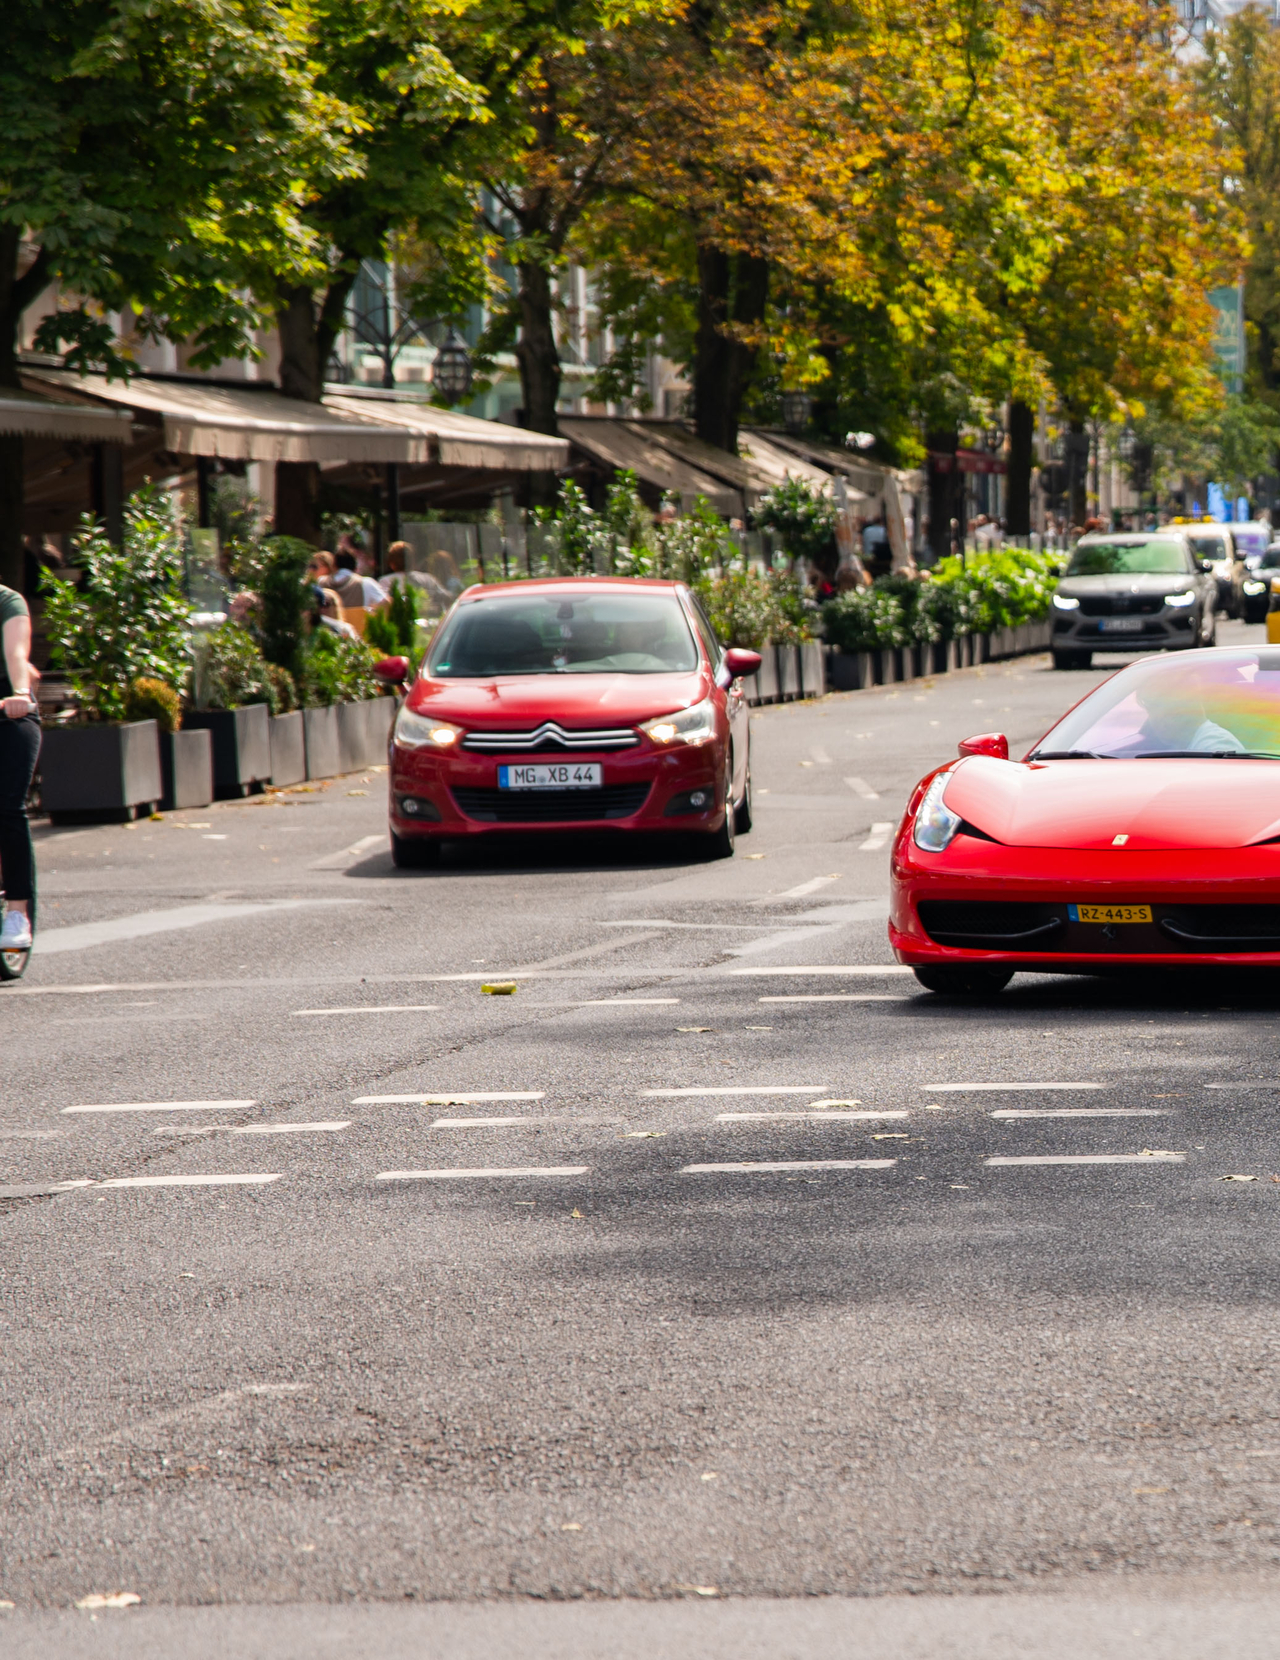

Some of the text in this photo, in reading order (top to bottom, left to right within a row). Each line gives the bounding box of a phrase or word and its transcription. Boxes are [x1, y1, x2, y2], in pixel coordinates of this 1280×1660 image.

[514, 766, 593, 784] MG XB 44
[1081, 908, 1148, 920] RZ-443-S
